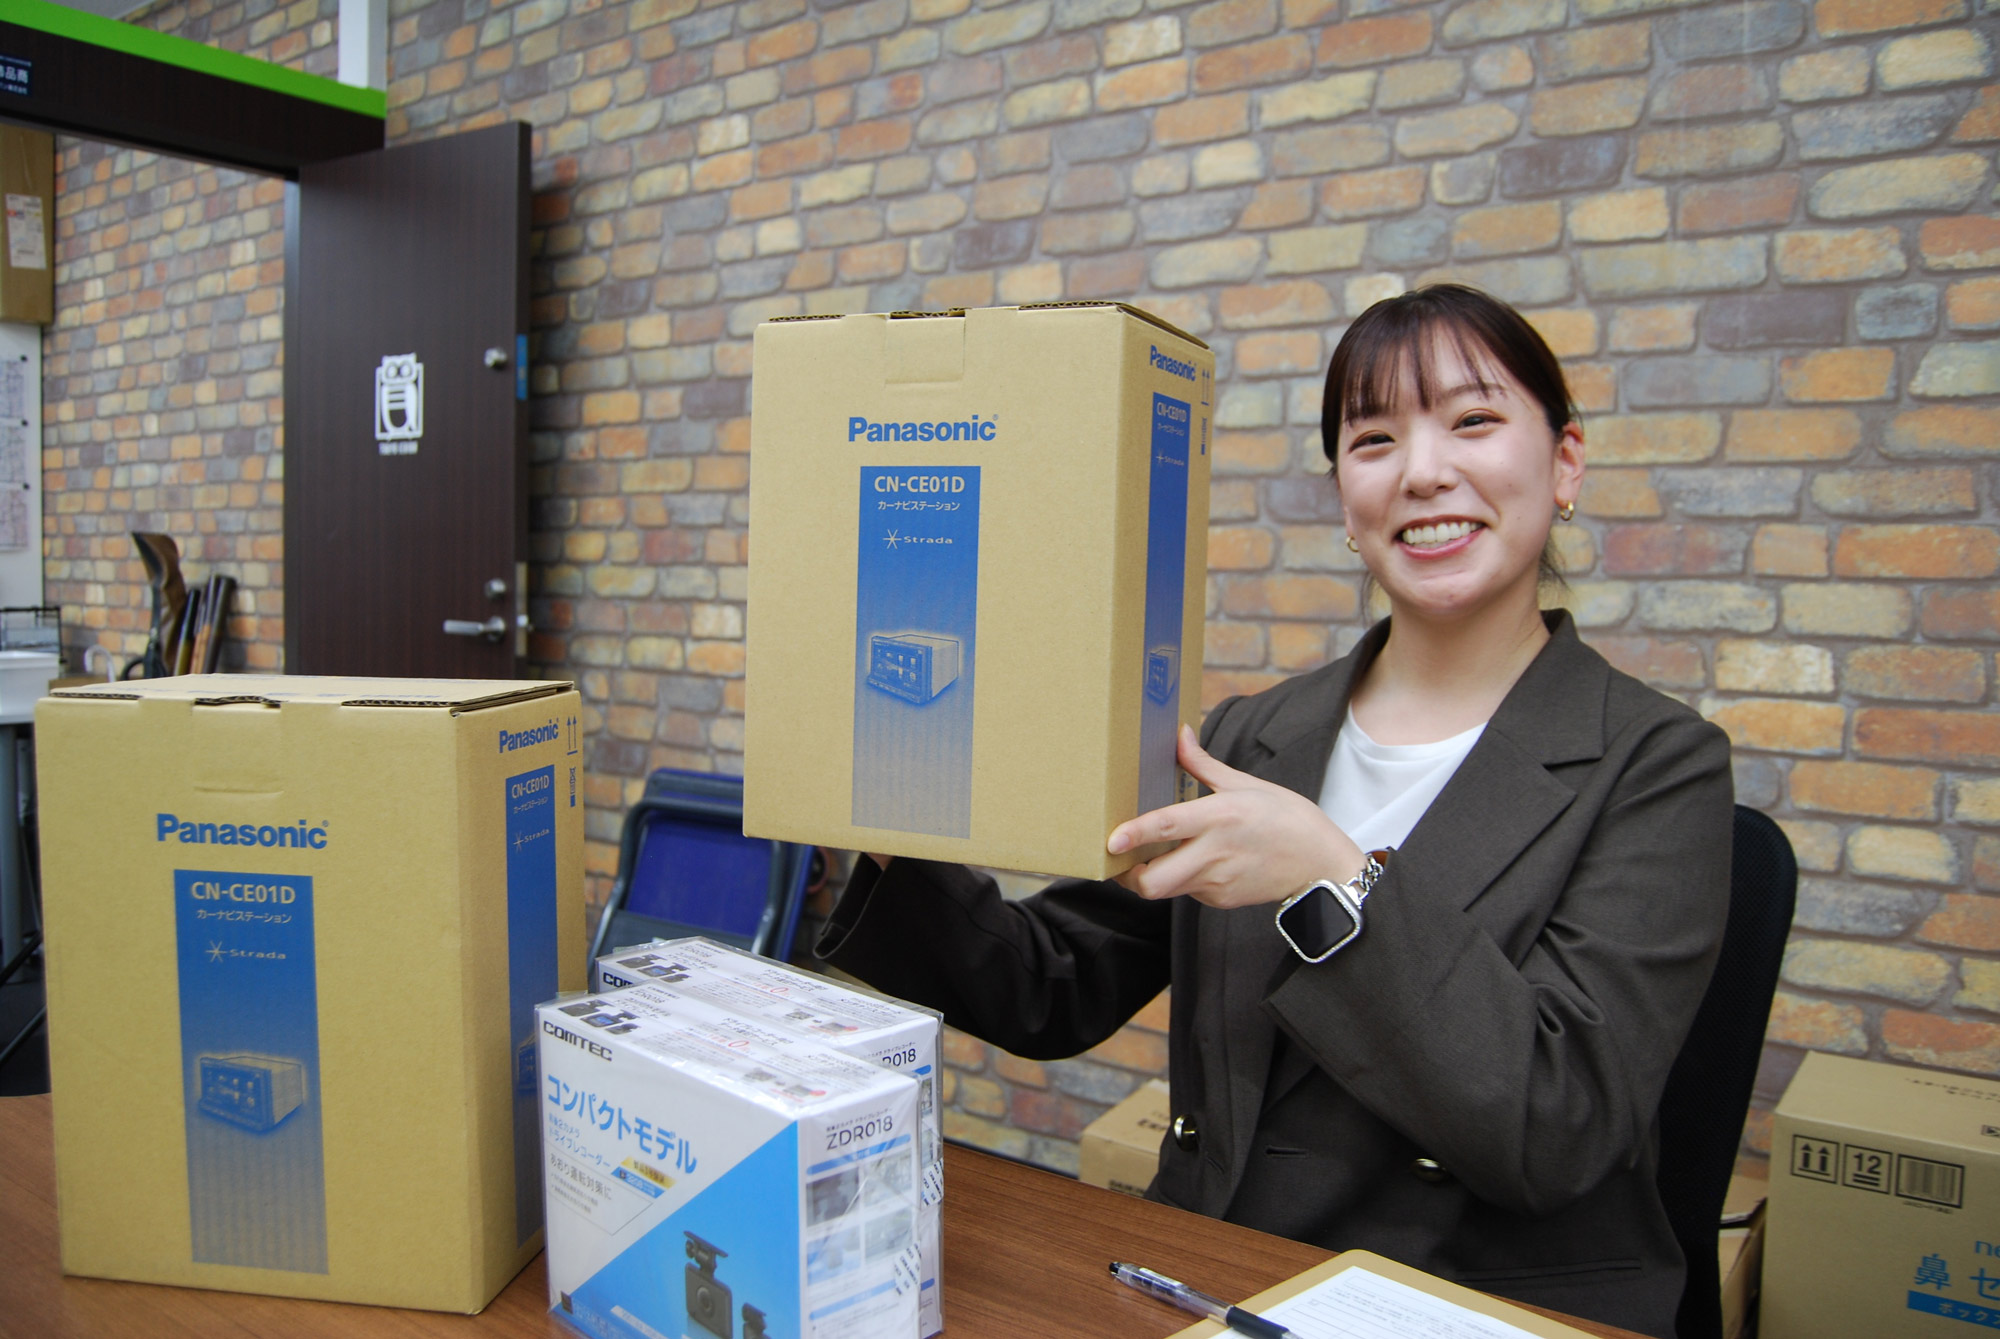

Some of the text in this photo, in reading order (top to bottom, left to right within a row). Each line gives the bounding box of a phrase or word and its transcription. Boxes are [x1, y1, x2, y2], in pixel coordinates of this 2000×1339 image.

[1149, 344, 1196, 382] Panasonic
[1156, 402, 1187, 423] CN-CE01D
[848, 414, 996, 442] Panasonic
[873, 475, 965, 493] CN-CE01D
[877, 500, 960, 511] カーナビステーション
[903, 535, 953, 544] Strada
[499, 718, 559, 753] Panasonic
[511, 774, 550, 799] CN-CE01D
[157, 813, 328, 849] Panasonic
[524, 828, 550, 843] Strada
[191, 881, 297, 904] CN-CE01D
[196, 908, 292, 924] カーナビステーション
[229, 948, 287, 960] Strada
[543, 1020, 613, 1062] COMTEC
[547, 1073, 697, 1174] コンパクトモデル
[826, 1115, 893, 1151] ZDR018
[549, 1126, 611, 1168] ドライブレコーダー
[1853, 1152, 1882, 1175] 12
